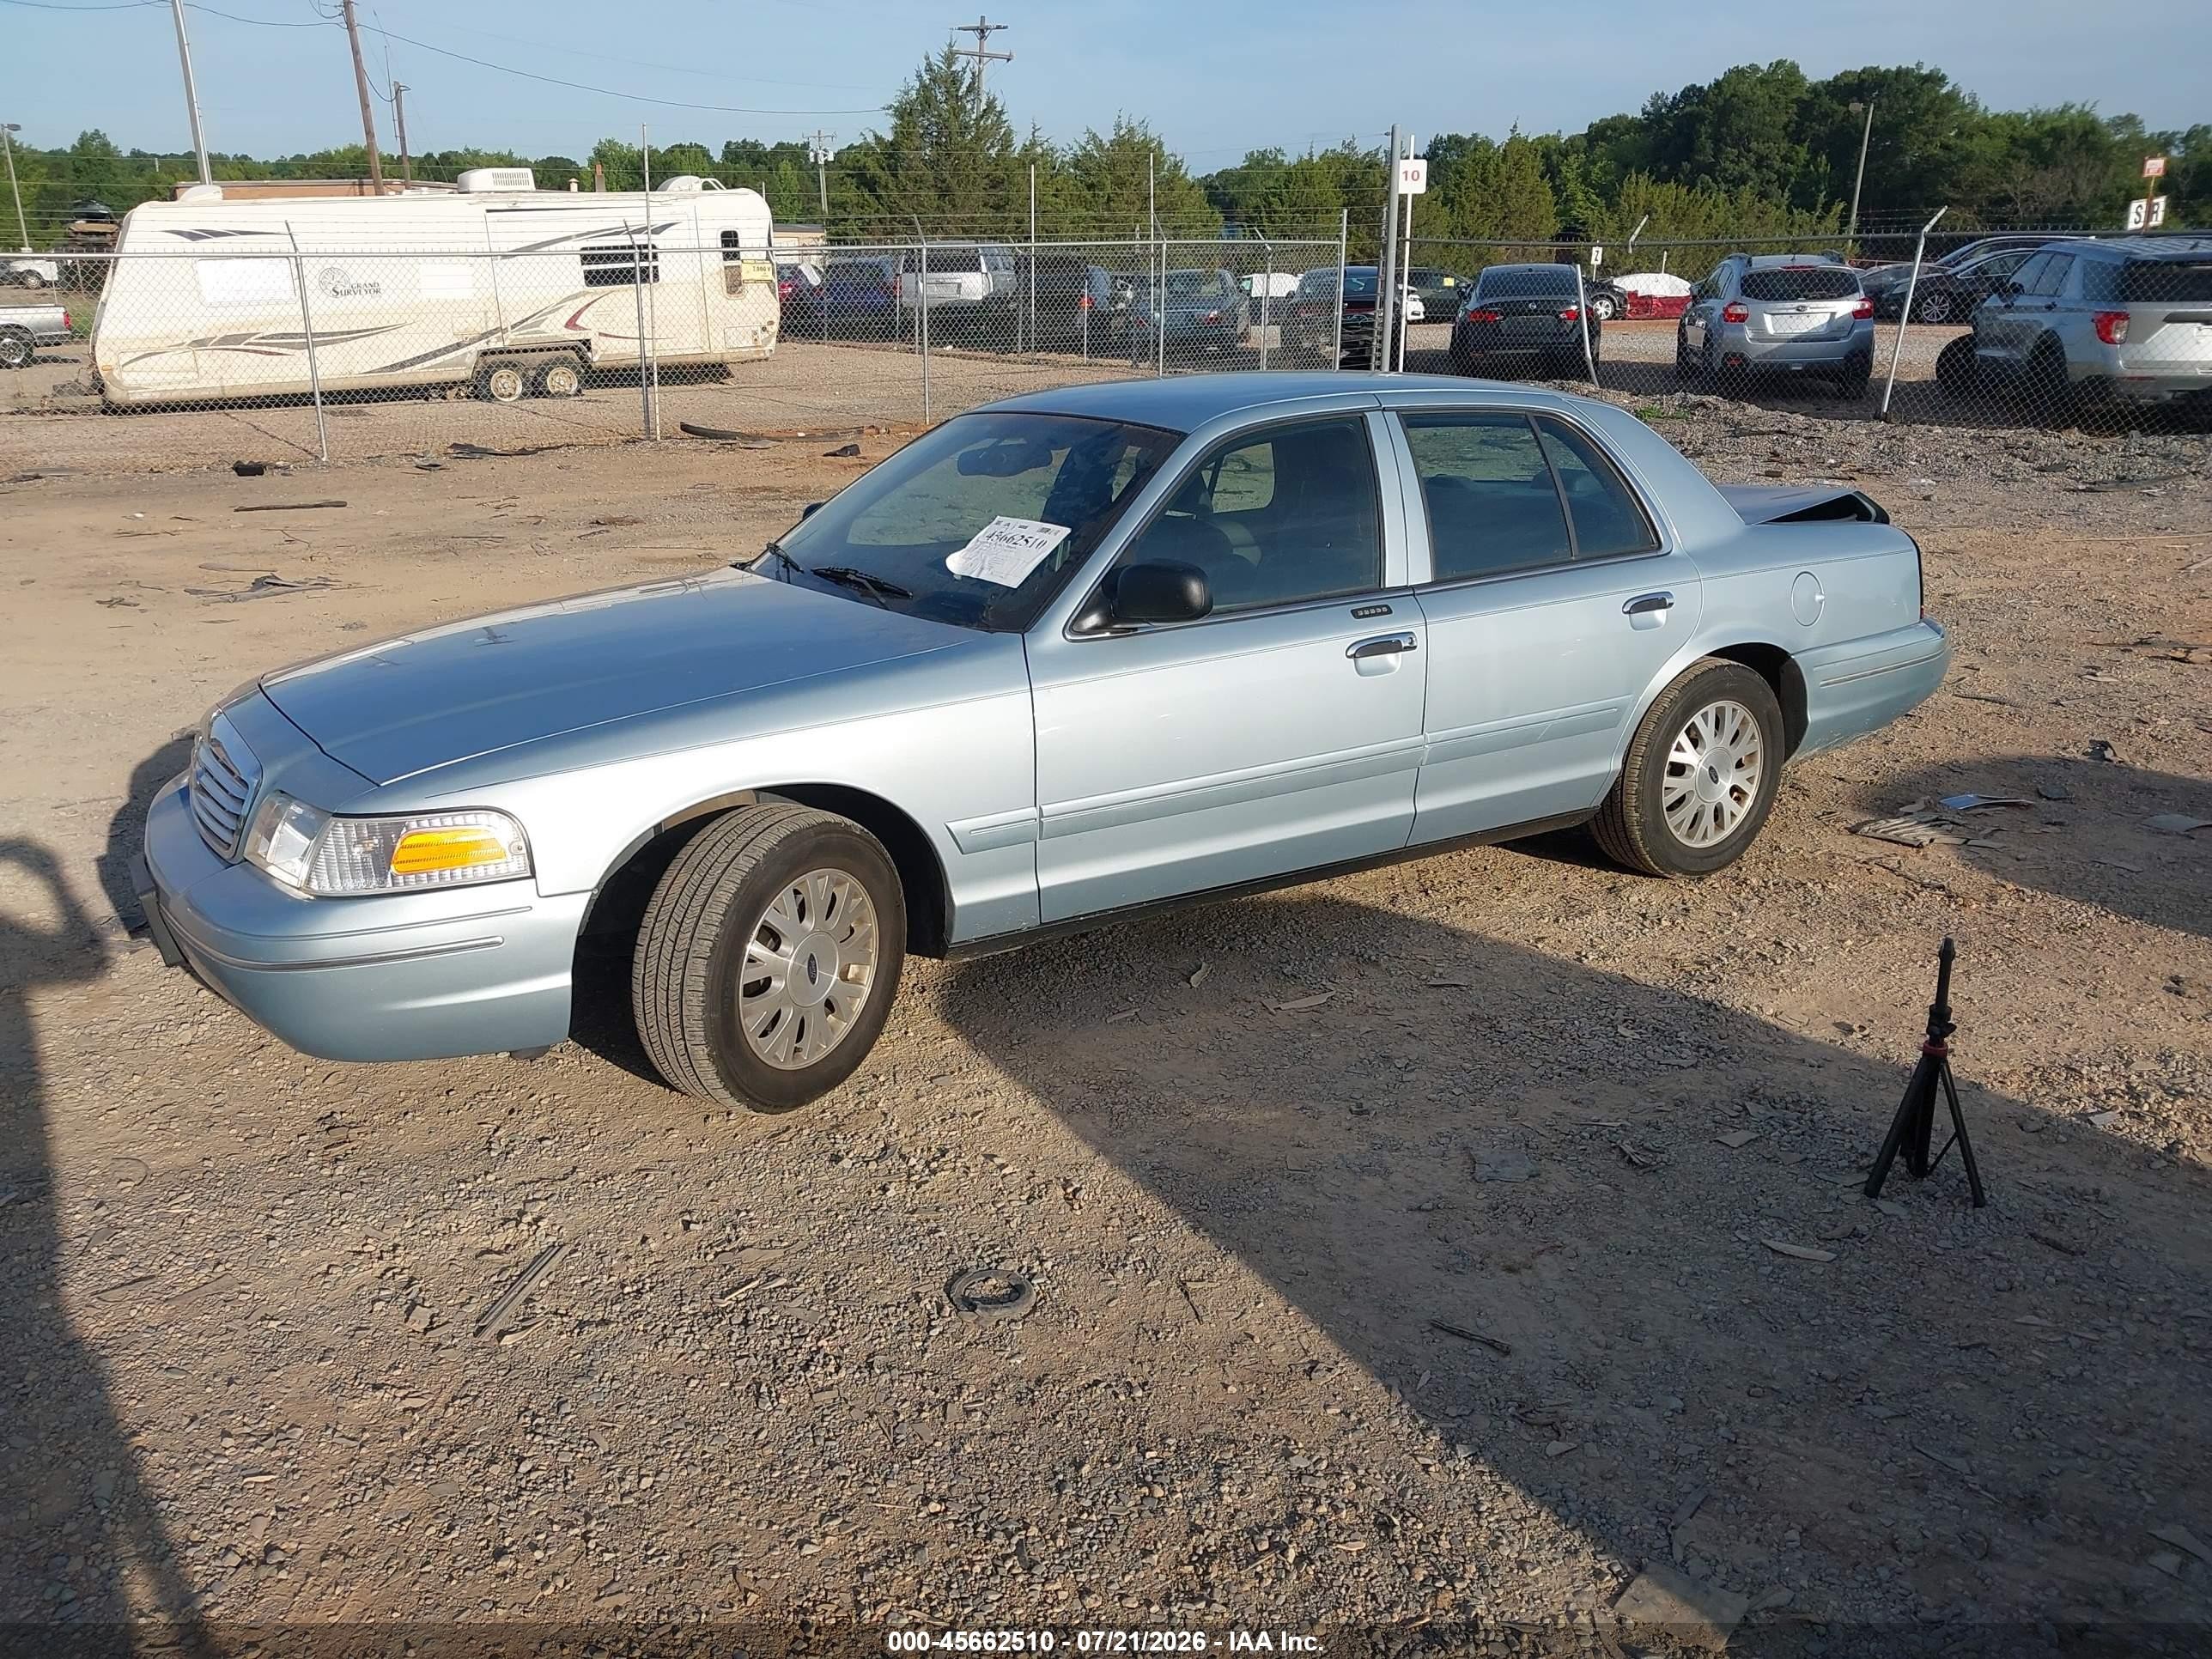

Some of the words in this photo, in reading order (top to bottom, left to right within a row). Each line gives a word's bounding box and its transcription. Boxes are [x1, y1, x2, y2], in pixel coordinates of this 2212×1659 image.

[1402, 170, 1420, 182] 10
[331, 286, 382, 297] SURVEYOR
[985, 530, 1048, 550] 45662510
